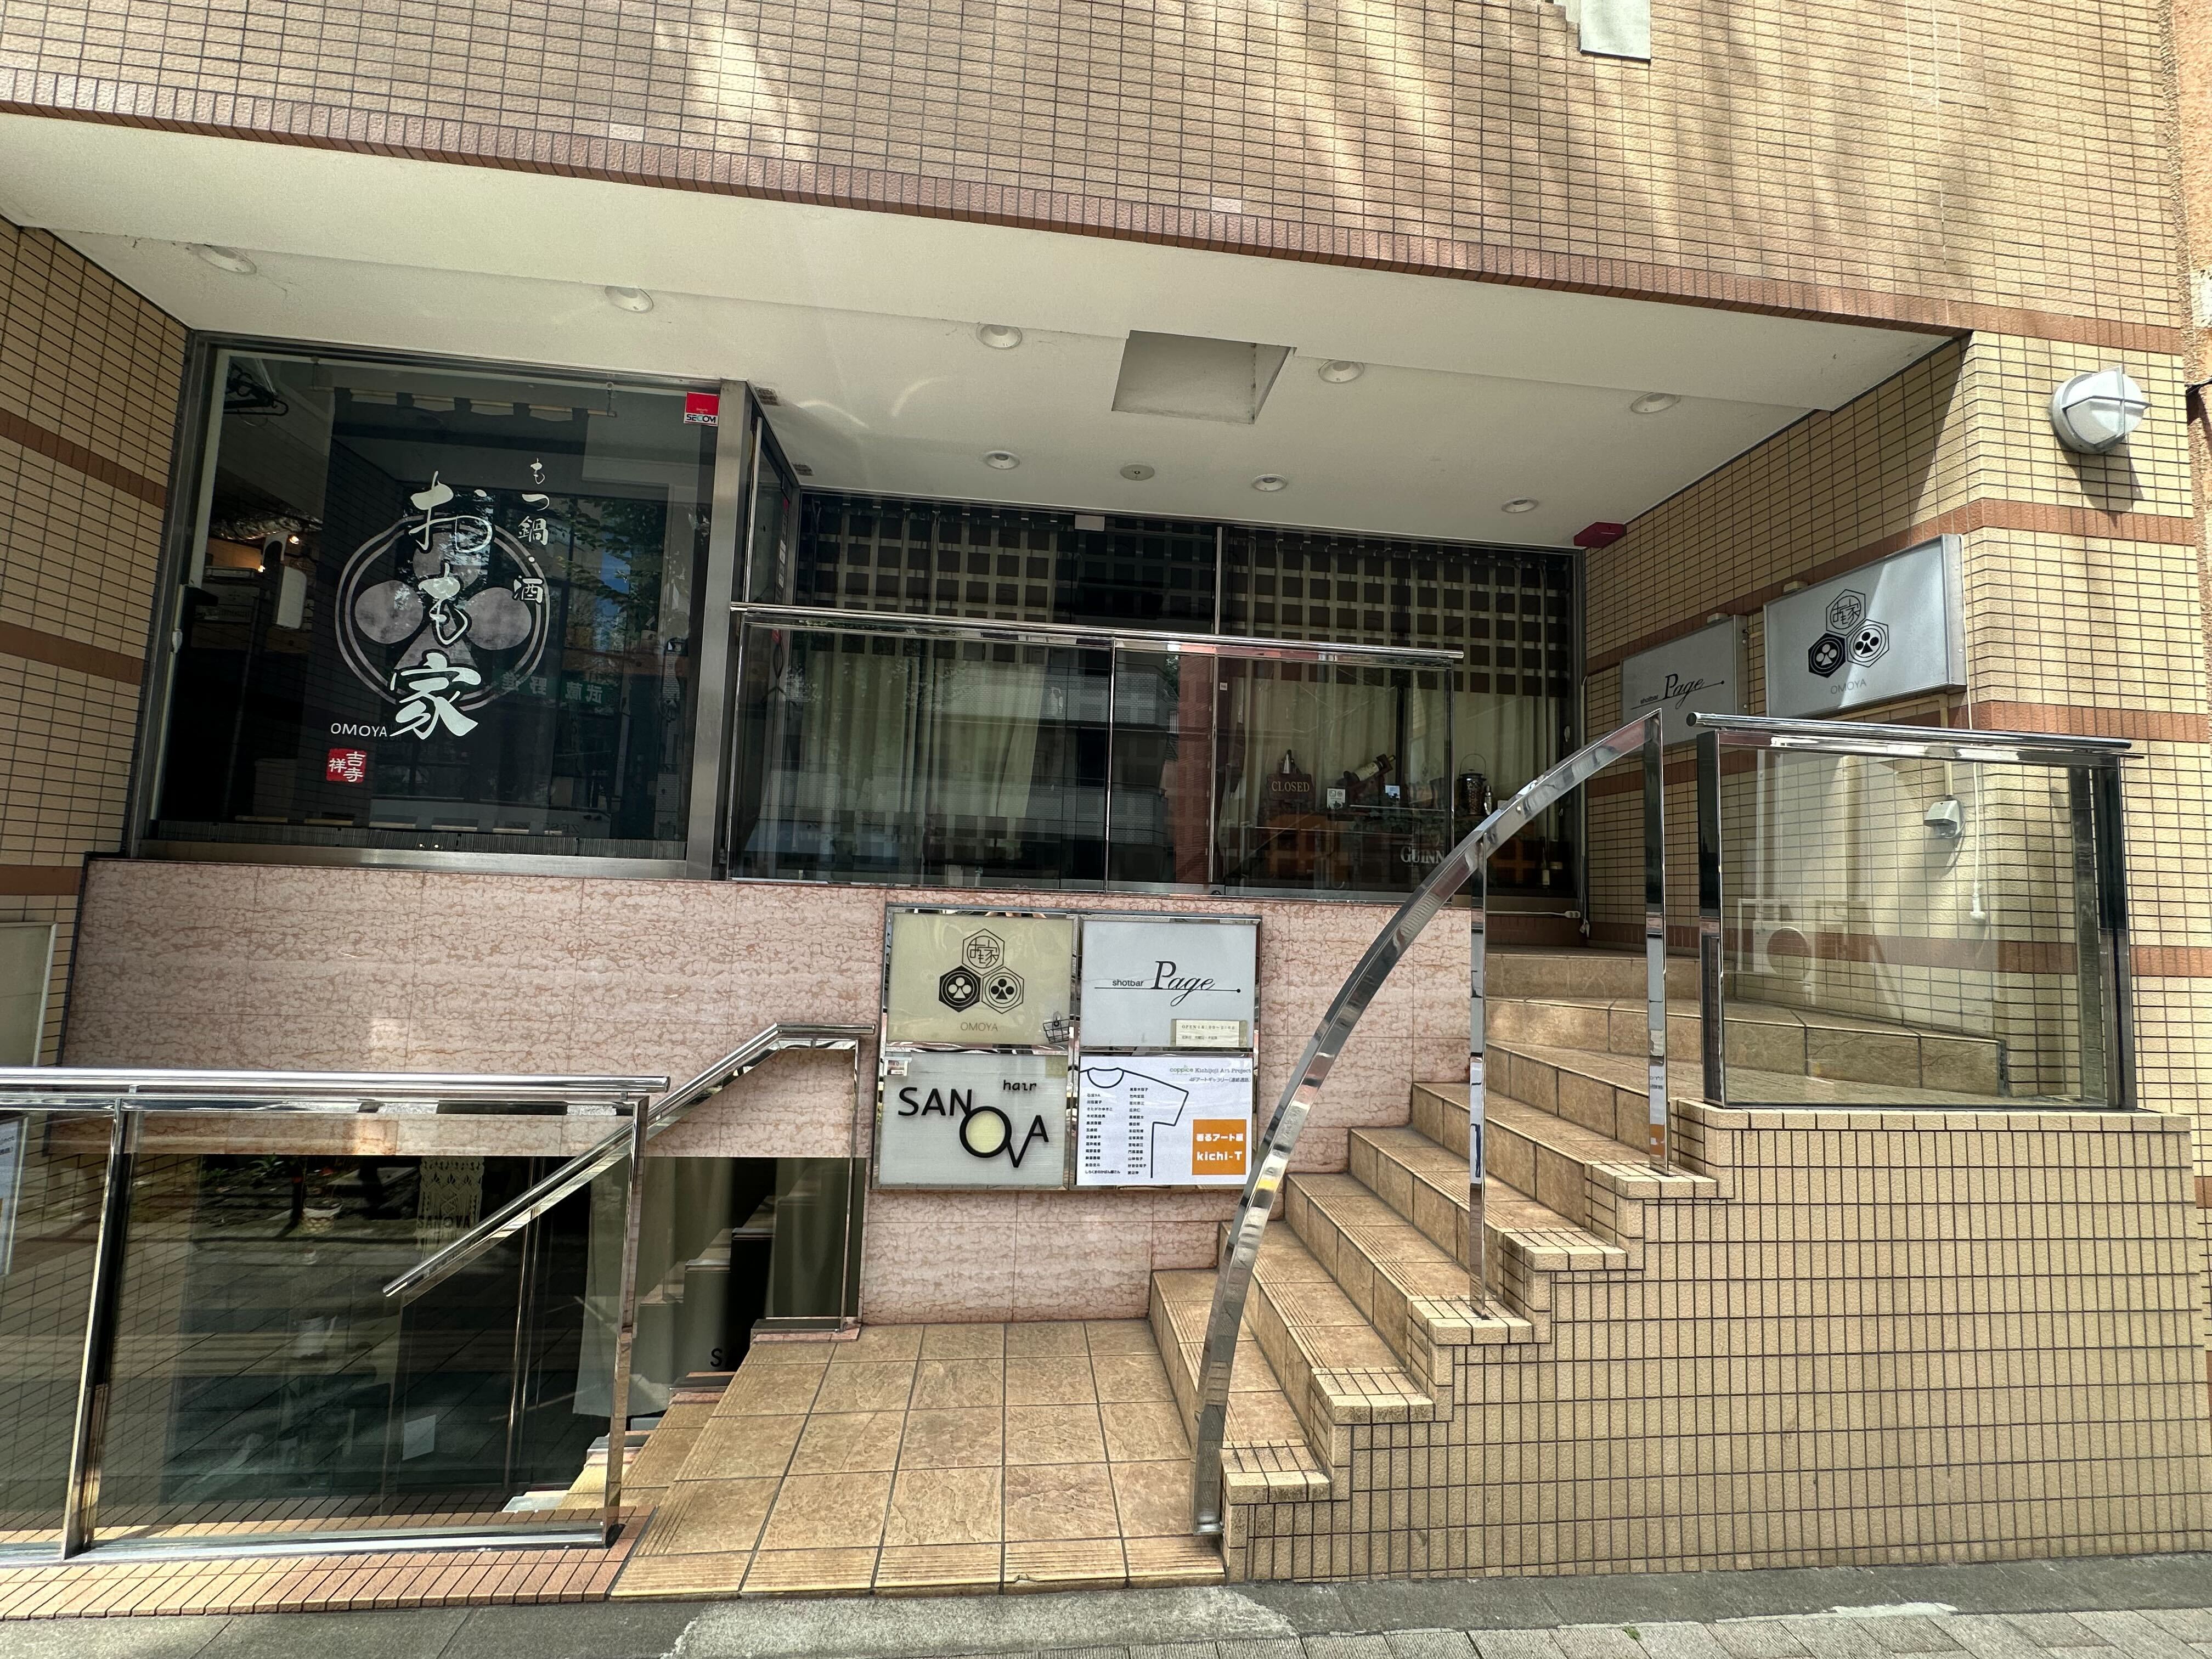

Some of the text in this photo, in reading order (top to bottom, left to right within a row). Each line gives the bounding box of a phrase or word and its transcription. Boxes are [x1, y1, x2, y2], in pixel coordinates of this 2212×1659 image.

[686, 414, 716, 424] SECOM
[1663, 673, 1705, 710] Page
[1830, 678, 1867, 695] OMOYA
[330, 723, 387, 737] OMOYA
[1271, 780, 1310, 793] CLOSED
[1112, 960, 1216, 1007] shotbar Page
[960, 1022, 998, 1032] OMOYA
[1003, 1079, 1037, 1091] hair
[1197, 1150, 1243, 1161] kichi-T
[417, 1215, 471, 1229] SANOVA
